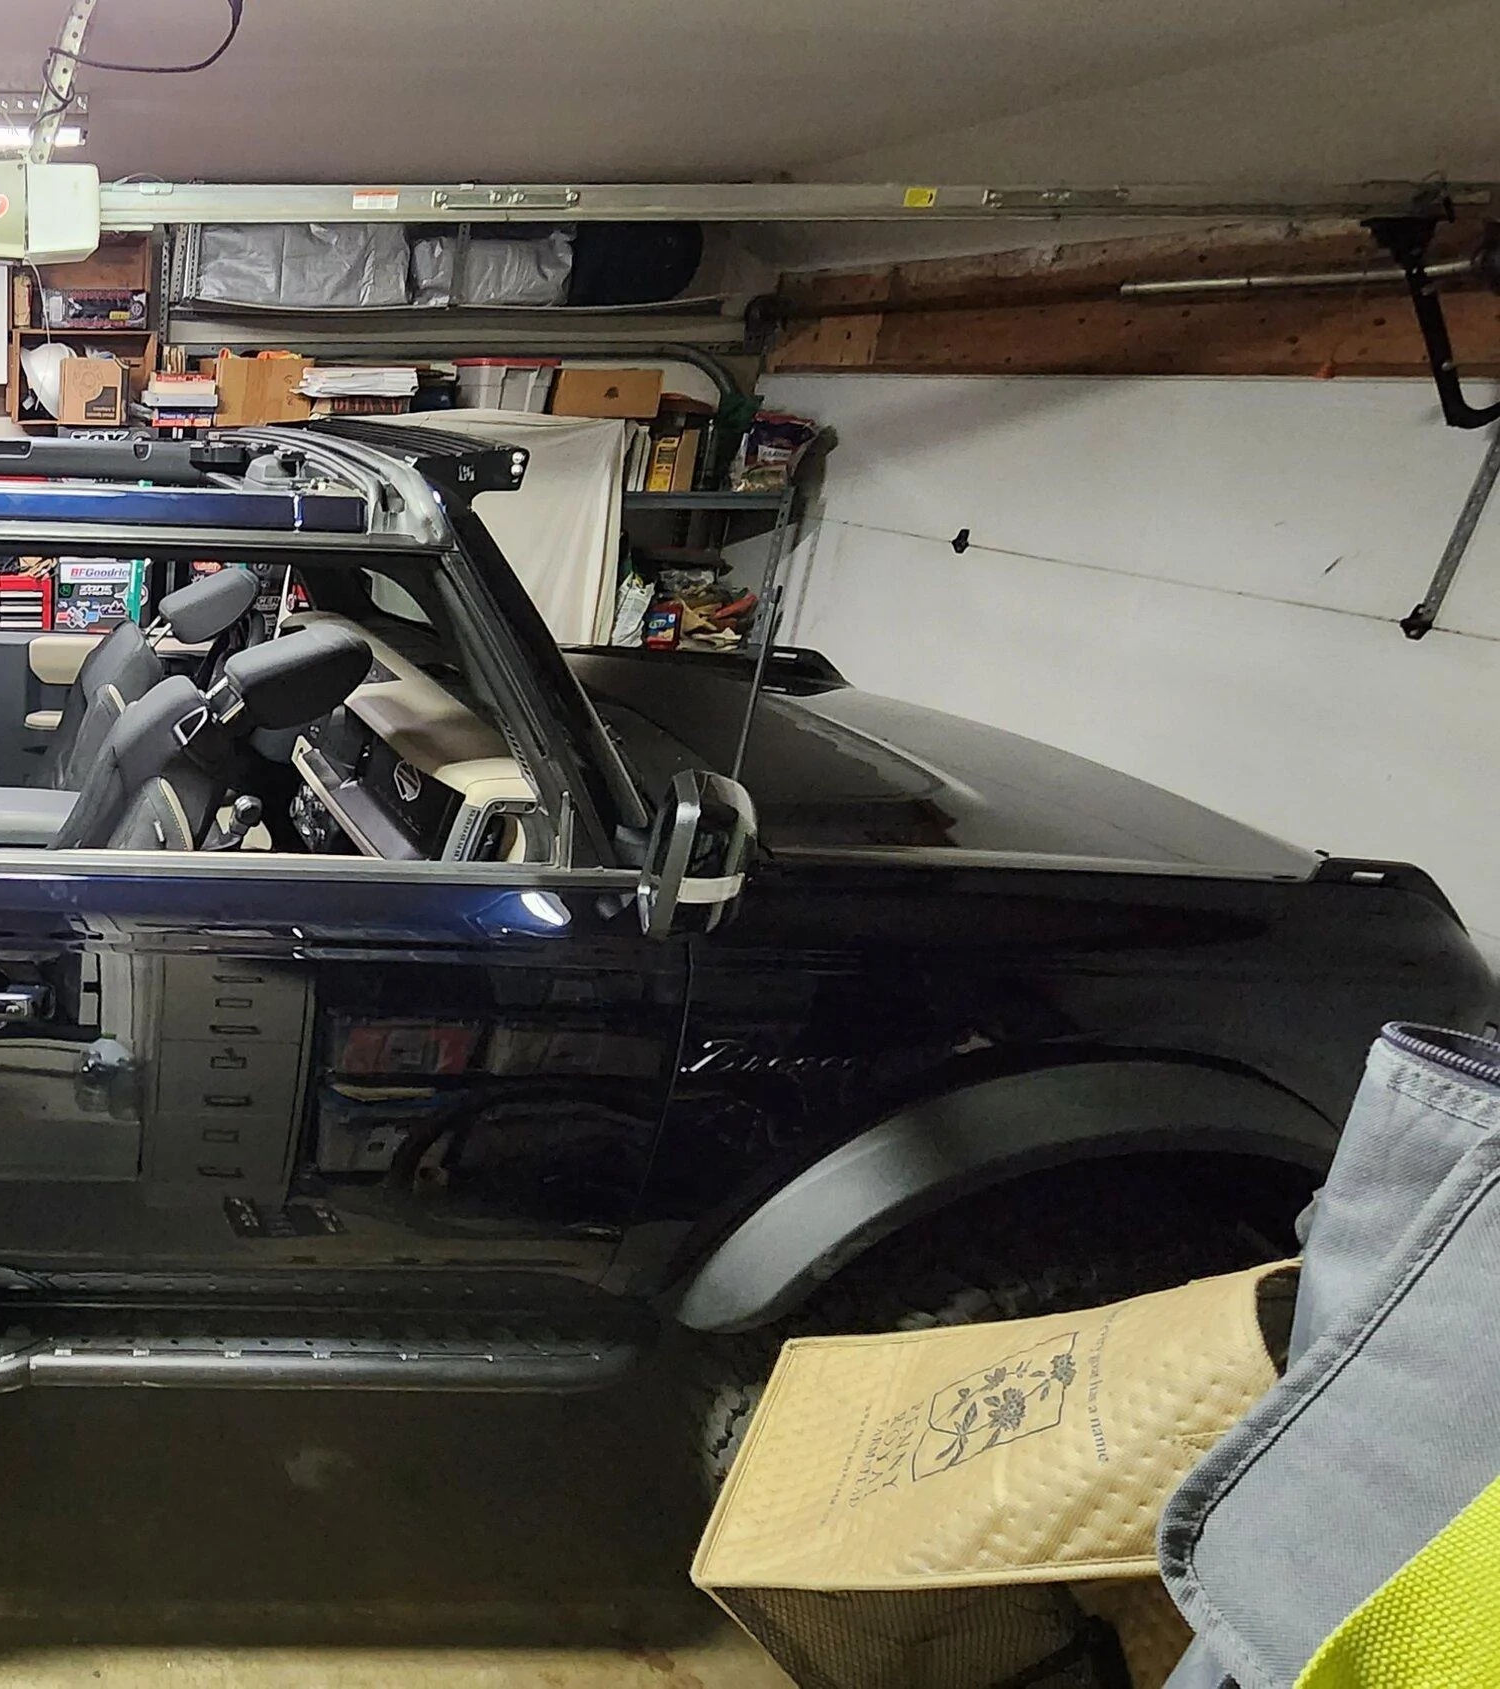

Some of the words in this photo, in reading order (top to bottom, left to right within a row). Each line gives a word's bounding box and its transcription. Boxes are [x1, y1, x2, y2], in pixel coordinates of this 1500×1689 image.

[70, 567, 130, 578] BFGoodric
[257, 596, 280, 605] CER
[1088, 1405, 1098, 1414] a
[1090, 1417, 1110, 1462] name
